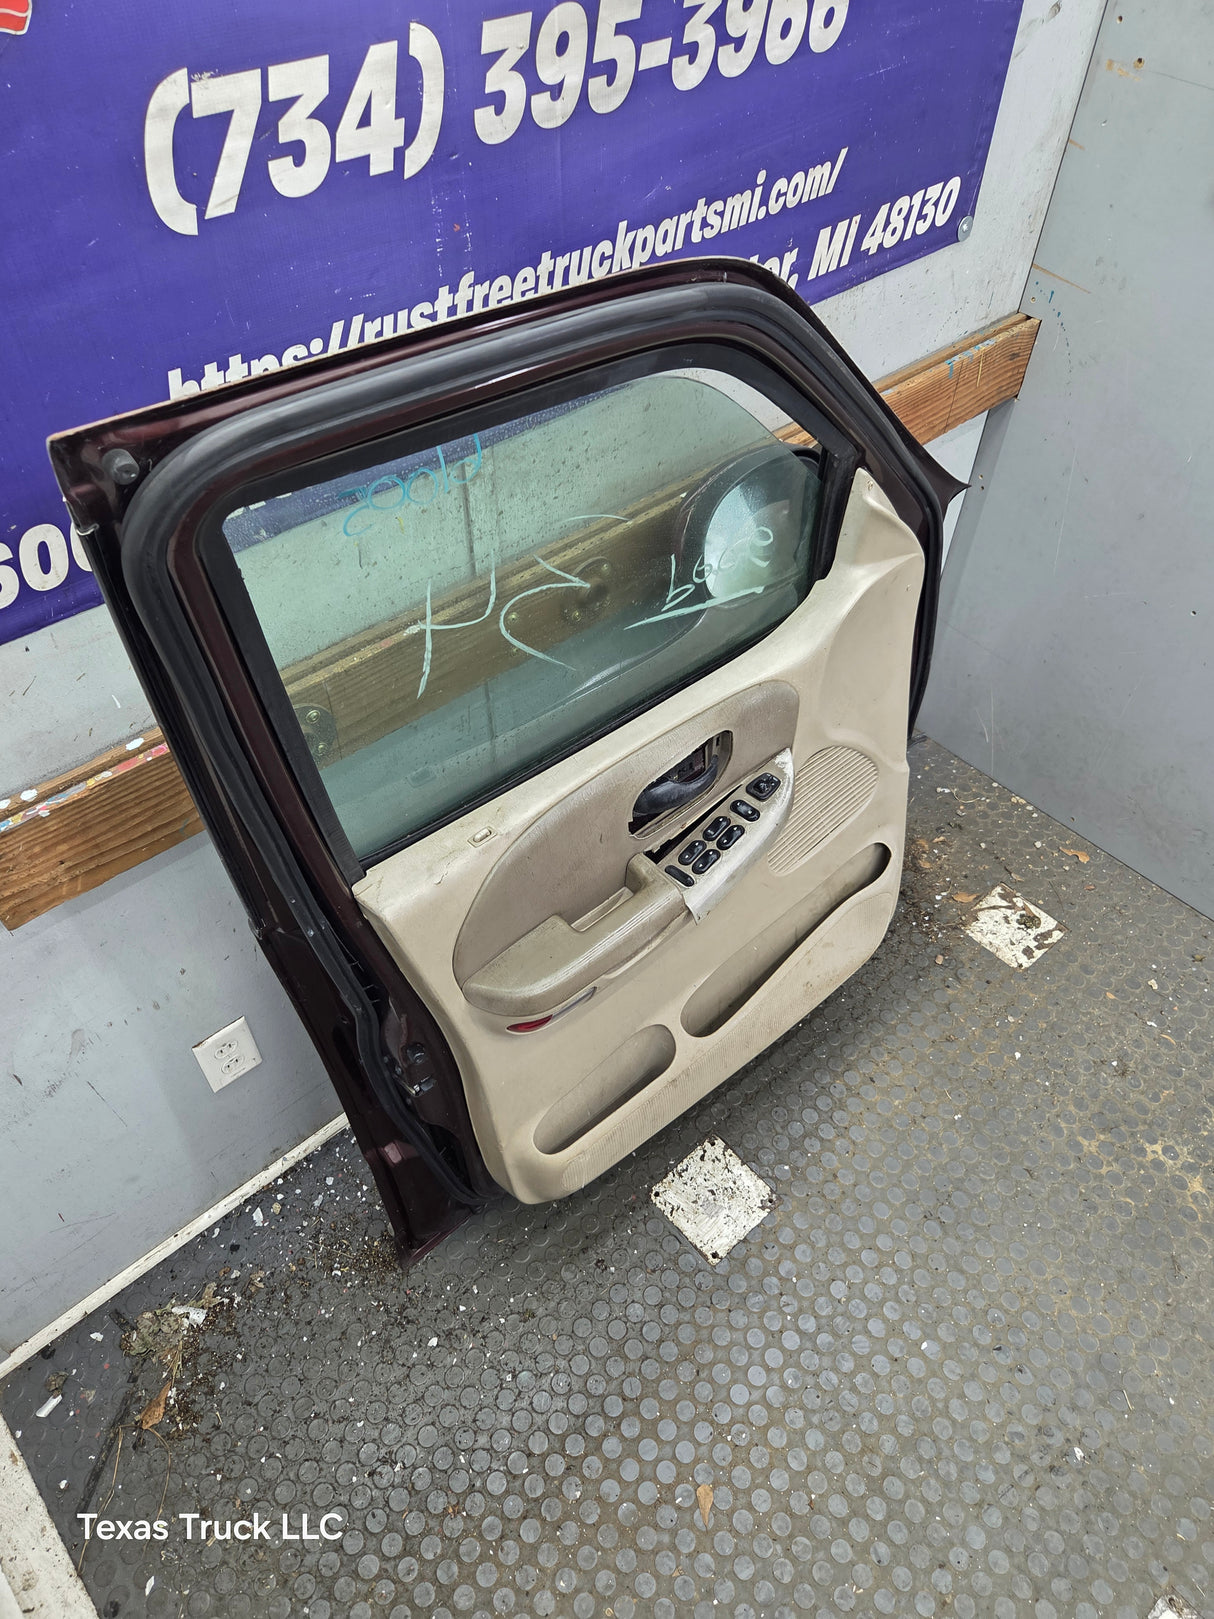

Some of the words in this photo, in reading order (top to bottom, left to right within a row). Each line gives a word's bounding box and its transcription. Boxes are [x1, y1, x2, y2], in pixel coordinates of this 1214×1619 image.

[144, 22, 445, 236] (734)
[807, 214, 861, 281] MI
[860, 176, 962, 256] 48130
